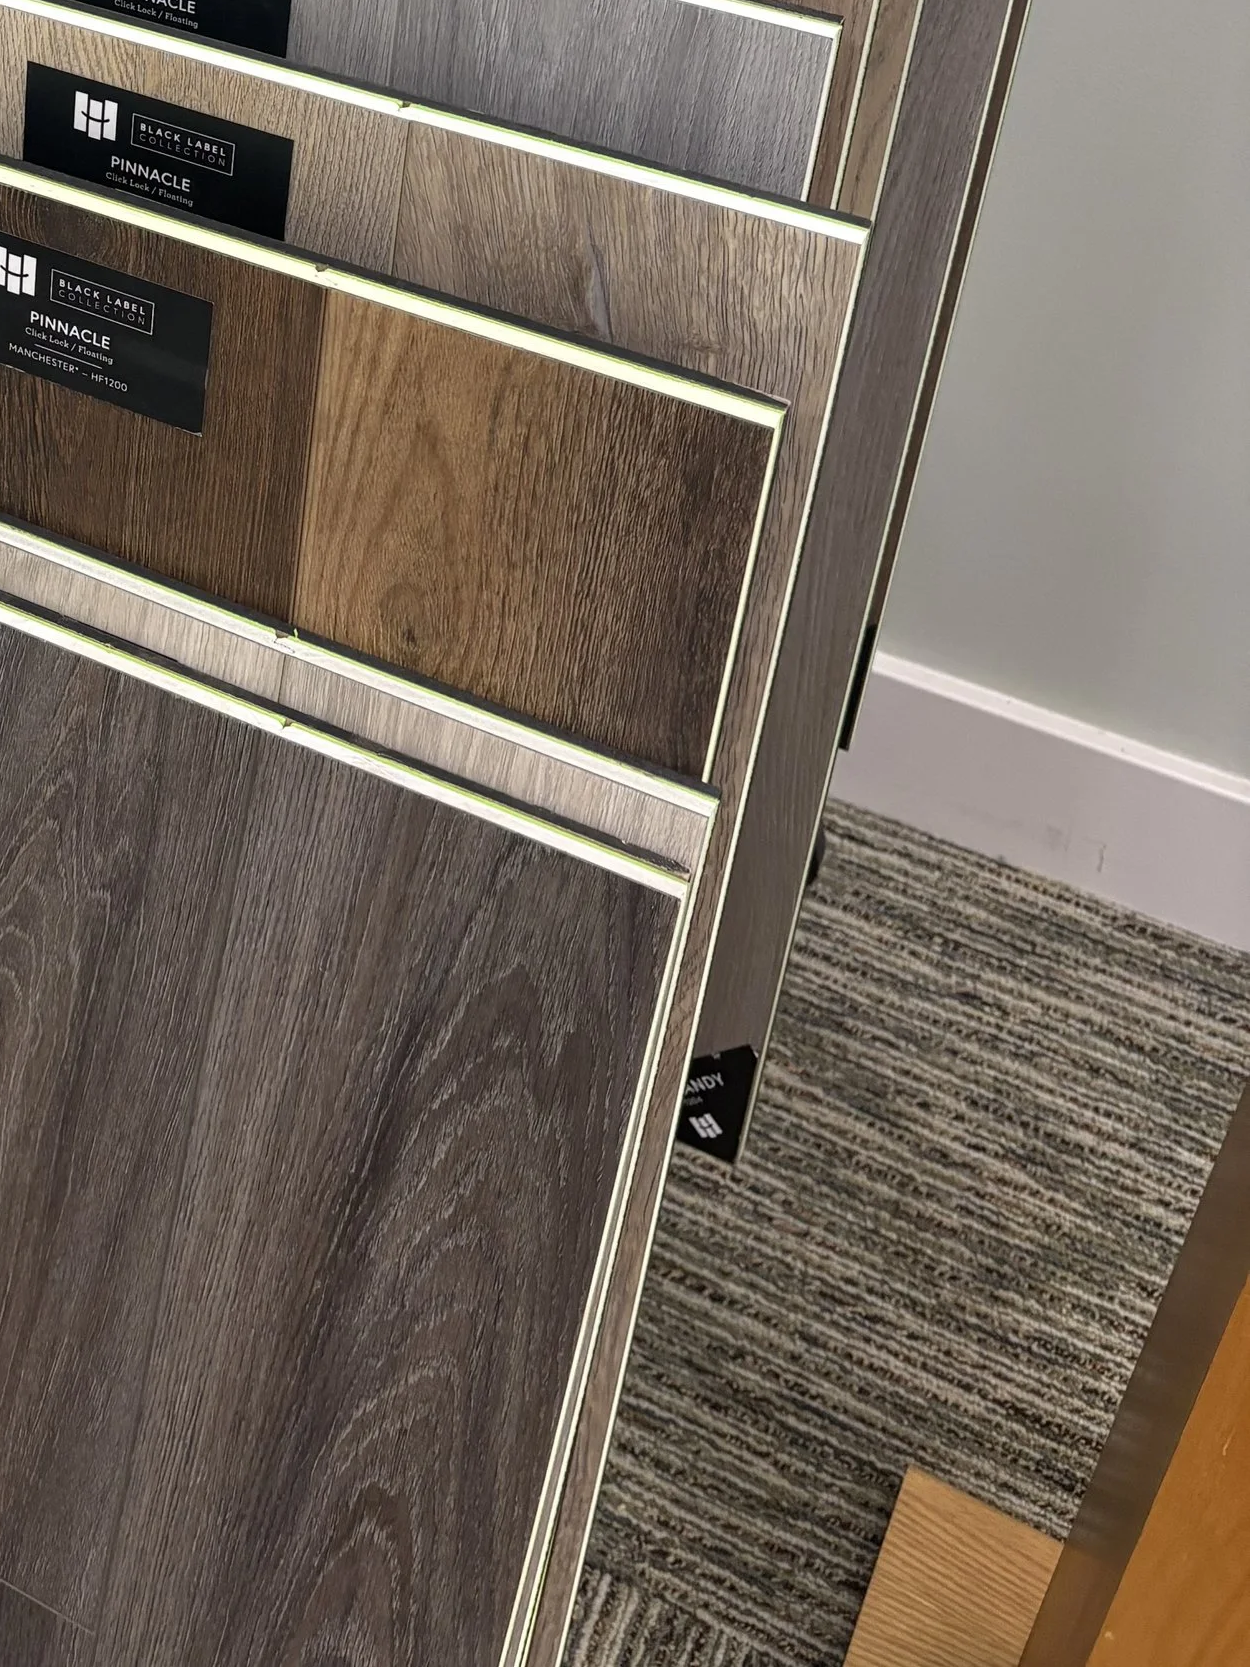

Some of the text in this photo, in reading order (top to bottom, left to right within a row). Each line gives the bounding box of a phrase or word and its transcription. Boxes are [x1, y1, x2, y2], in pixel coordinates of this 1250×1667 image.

[137, 4, 157, 17] Lock
[165, 12, 199, 30] Floating
[139, 133, 226, 167] COLLECTION
[140, 122, 227, 157] BLACK LABEL
[105, 171, 128, 185] Click
[130, 178, 150, 193] Lock
[158, 188, 194, 208] Floating
[111, 155, 191, 193] PINNACLE
[58, 289, 145, 325] COLLECTION
[59, 278, 146, 315] BLACK LABEL
[25, 326, 47, 341] Click
[49, 334, 69, 351] Lock
[78, 345, 113, 365] Floating
[30, 310, 111, 350] PINNACLE
[91, 372, 128, 392] HF1200
